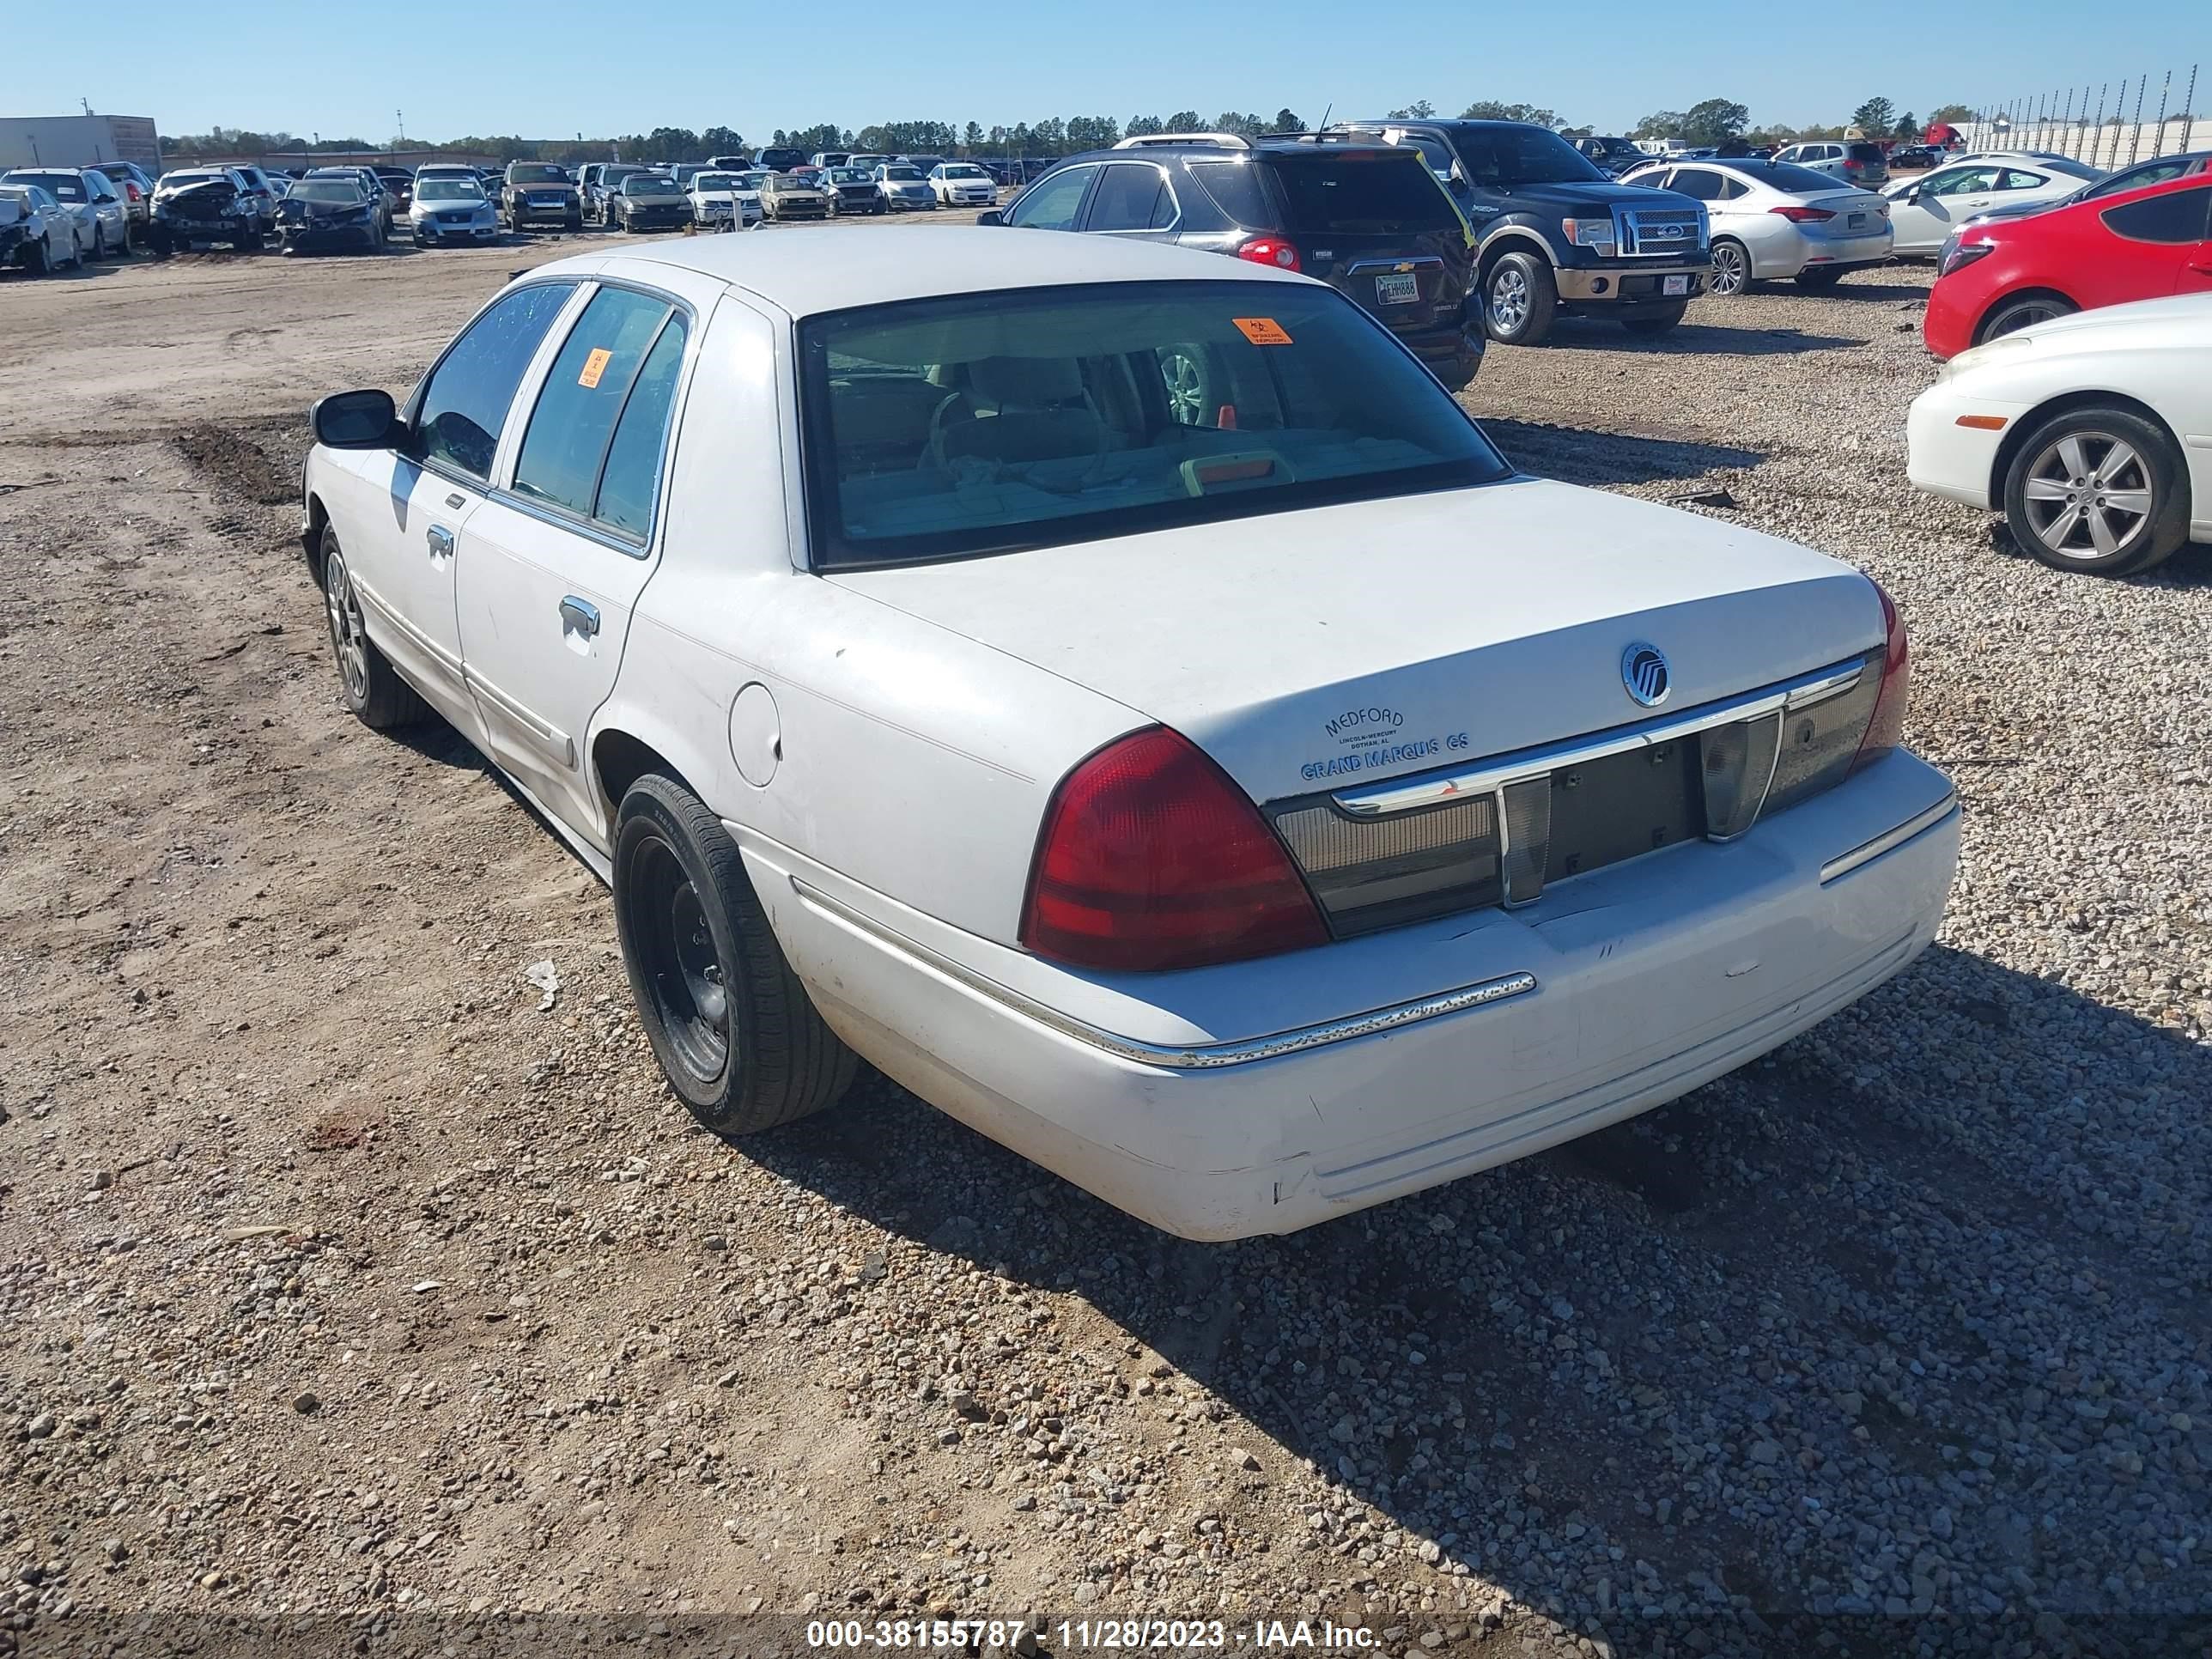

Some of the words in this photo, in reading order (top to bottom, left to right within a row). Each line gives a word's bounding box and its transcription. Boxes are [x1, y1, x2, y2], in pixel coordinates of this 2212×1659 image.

[1325, 708, 1404, 738] MEDFORD
[1301, 755, 1361, 781] GRAND
[1365, 739, 1440, 769] MARQUIS
[1446, 732, 1469, 751] GS
